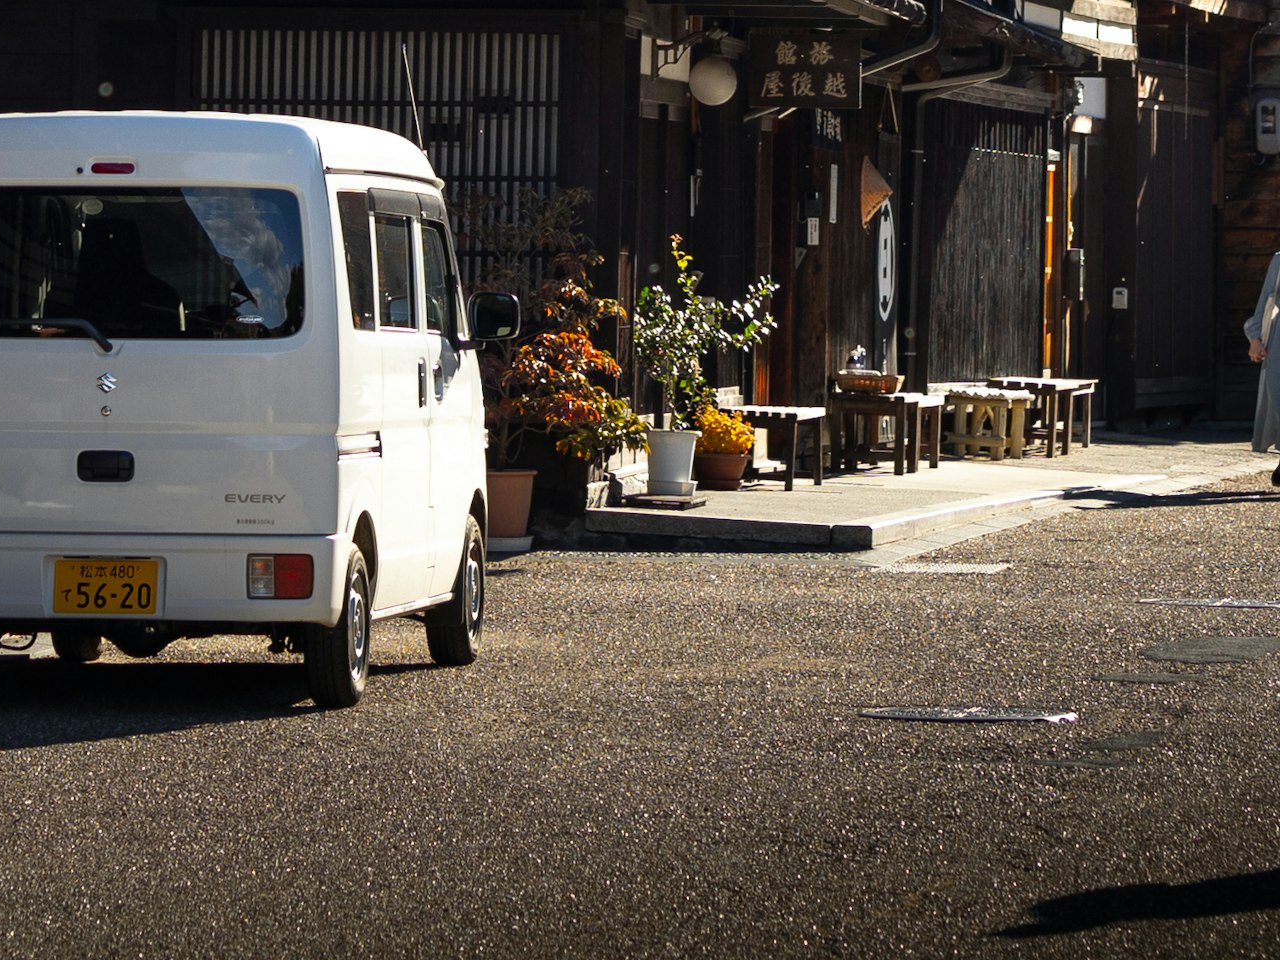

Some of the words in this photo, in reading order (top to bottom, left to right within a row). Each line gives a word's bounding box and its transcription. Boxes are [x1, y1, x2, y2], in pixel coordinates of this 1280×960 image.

[761, 71, 848, 98] 越後屋
[224, 493, 287, 504] EVERY
[60, 588, 72, 603] て
[76, 582, 152, 609] 56-20
